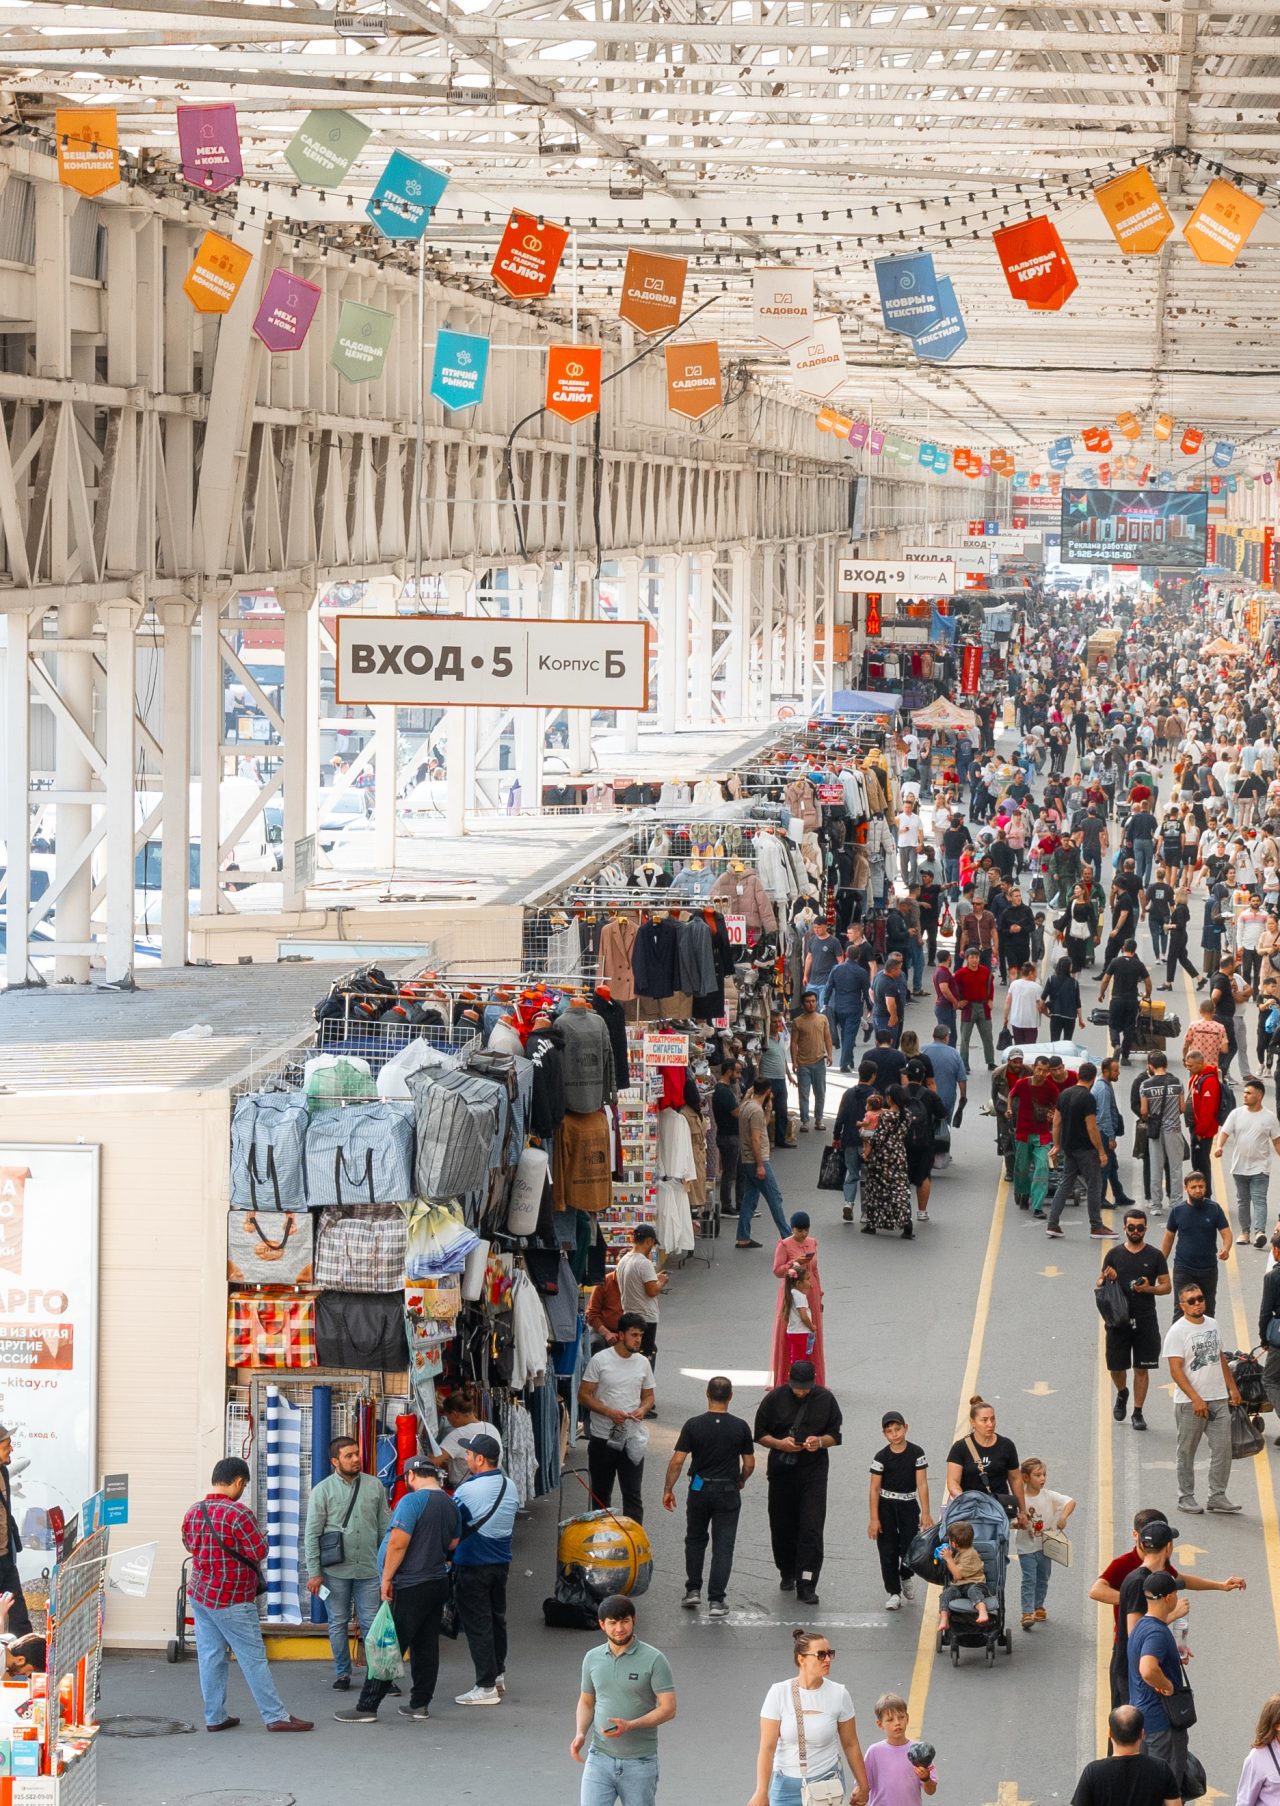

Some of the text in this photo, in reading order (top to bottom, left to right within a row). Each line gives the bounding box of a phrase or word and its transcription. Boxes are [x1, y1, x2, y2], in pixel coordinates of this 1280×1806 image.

[63, 151, 113, 160] ВЕЩЕВОЙ
[196, 146, 225, 156] МЕХА
[301, 133, 348, 169] САДОВЫЙ
[64, 160, 114, 170] КОМПЛЕКС
[200, 155, 230, 165] КОЖА
[303, 147, 335, 170] ЦЕНТР
[1116, 203, 1160, 231] ВЕЩЕВОЙ
[1120, 214, 1165, 239] КОМПЛЕКС
[1200, 212, 1242, 243] ВЕЩЕВОЙ
[1195, 222, 1237, 252] КОМПЛЕКС
[1009, 251, 1056, 273] ПАЛЬТОВЫЙ
[501, 260, 546, 283] САЛЮТ
[1018, 261, 1052, 282] КРУГ
[196, 266, 236, 293] ВЕЩЕВОЙ
[192, 274, 231, 300] КОМПЛЕКС
[628, 289, 676, 305] САДОВОД
[886, 298, 924, 309] КОВРЫ
[274, 308, 297, 324] МЕХА
[760, 307, 807, 315] САДОВОД
[887, 304, 936, 318] ТЕКСТИЛЬ
[273, 316, 296, 334] КОЖА
[916, 326, 960, 345] ТЕКСТИЛЬ
[339, 337, 383, 358] САДОВЫЙ
[345, 348, 374, 362] ЦЕНТР
[796, 354, 839, 369] САДОВОД
[442, 368, 478, 380] ПТИЧИЙ
[442, 378, 476, 390] РЫНОК
[672, 377, 716, 388] САДОВОД
[553, 392, 593, 402] САЛЮТ
[963, 540, 988, 549] ВХОД
[991, 540, 996, 548] 7
[1069, 541, 1136, 551] Реклама работает
[844, 570, 947, 584] ВХОД 9 А
[352, 644, 626, 681] ВХОД 5 Корпус Б
[652, 1044, 683, 1054] СИГАРЕТЫ
[646, 1055, 661, 1063] ОПТОМ
[667, 1055, 687, 1064] РОЗНИЦА
[11, 1329, 68, 1339] ИЗ КИТАЯ
[0, 1378, 58, 1390] -kitay.ru
